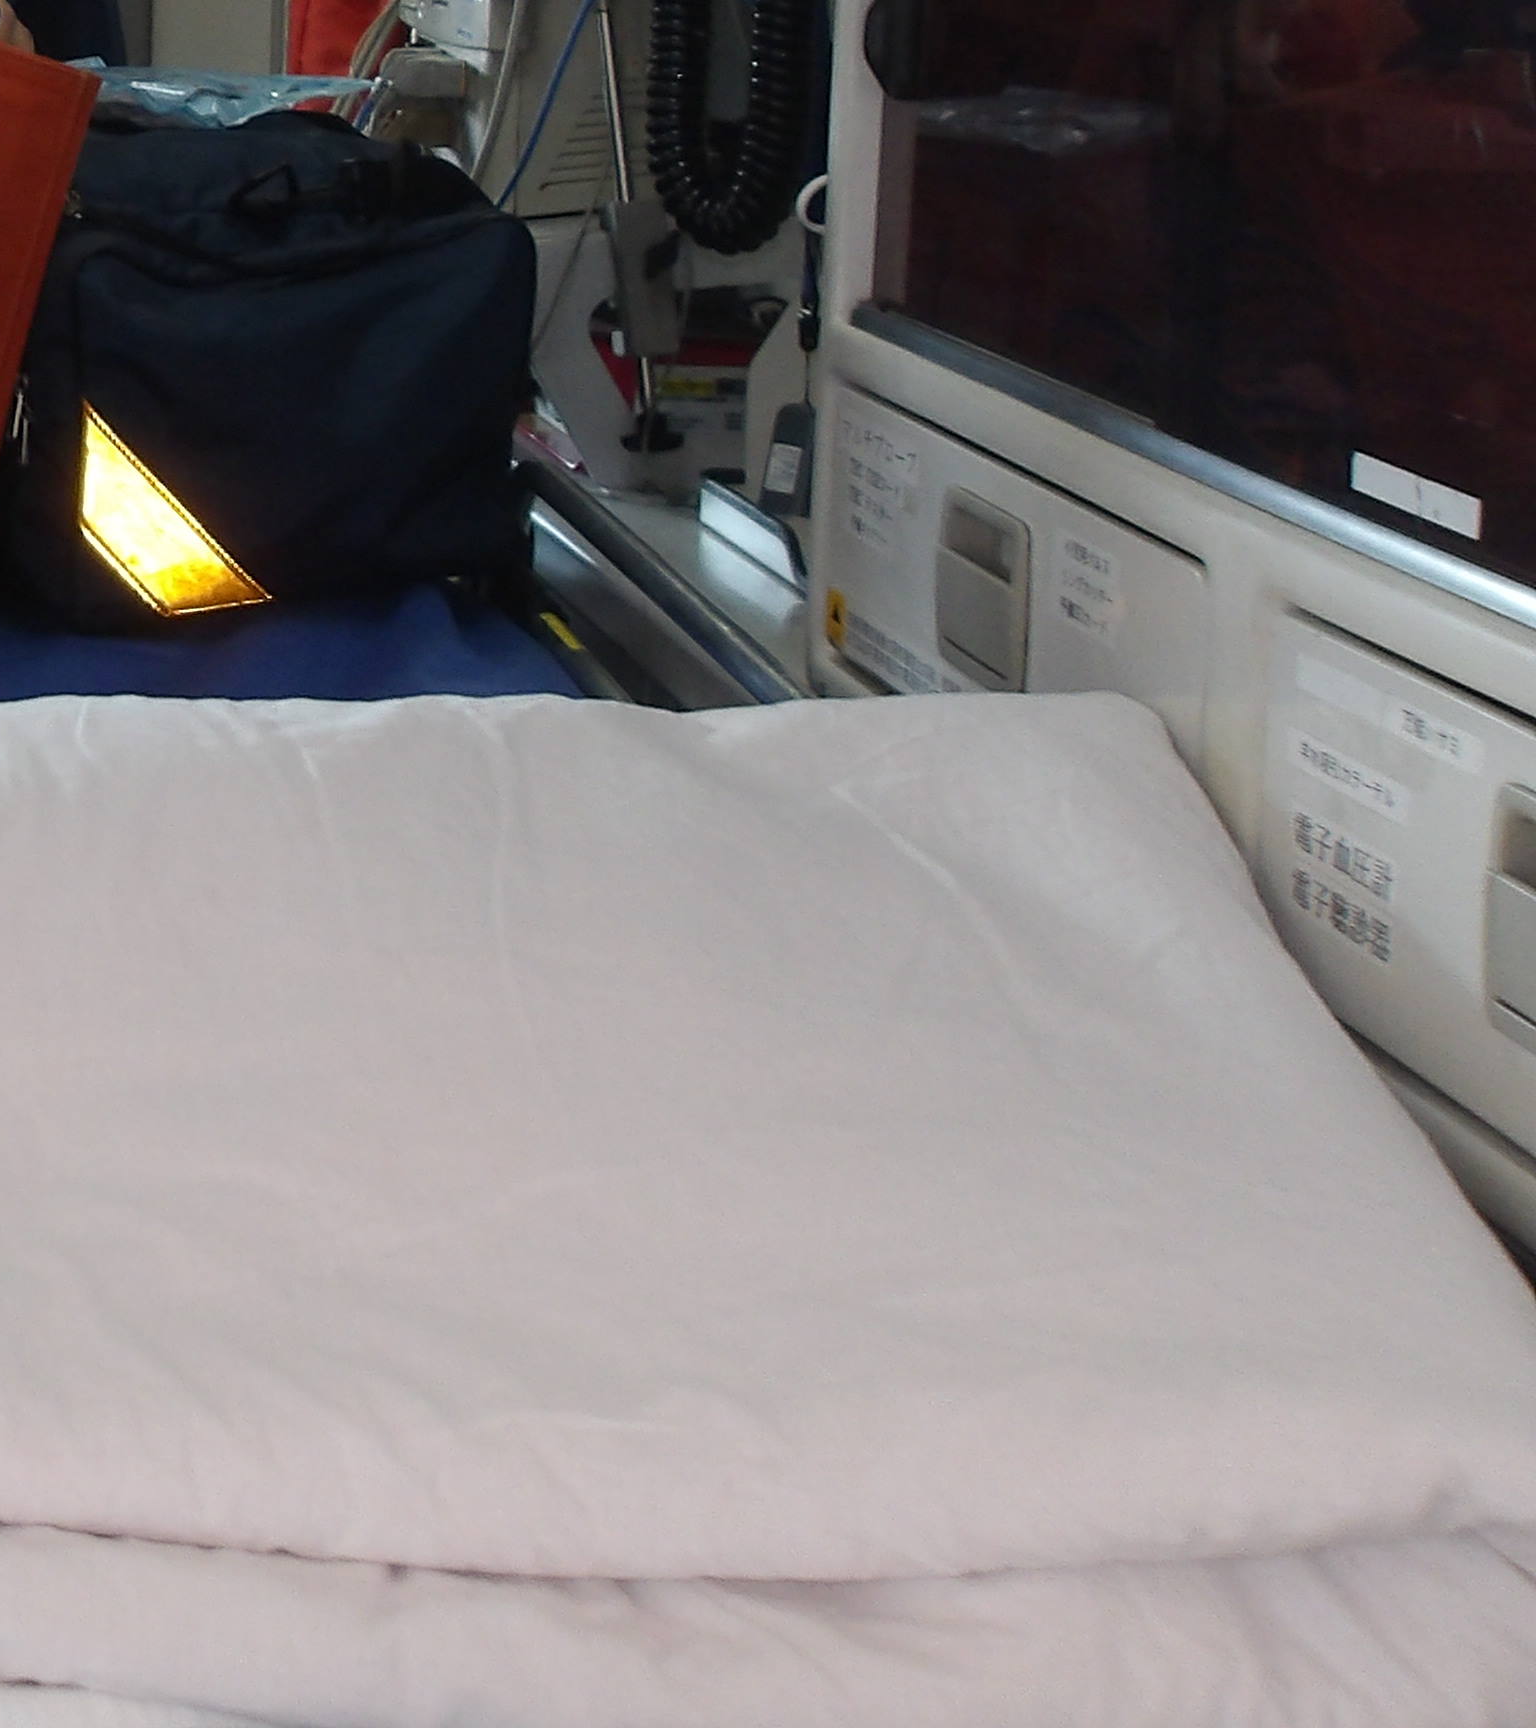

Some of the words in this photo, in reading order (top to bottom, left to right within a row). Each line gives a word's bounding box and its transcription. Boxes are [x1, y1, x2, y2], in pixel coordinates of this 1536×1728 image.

[1292, 811, 1395, 902] 電子血圧計
